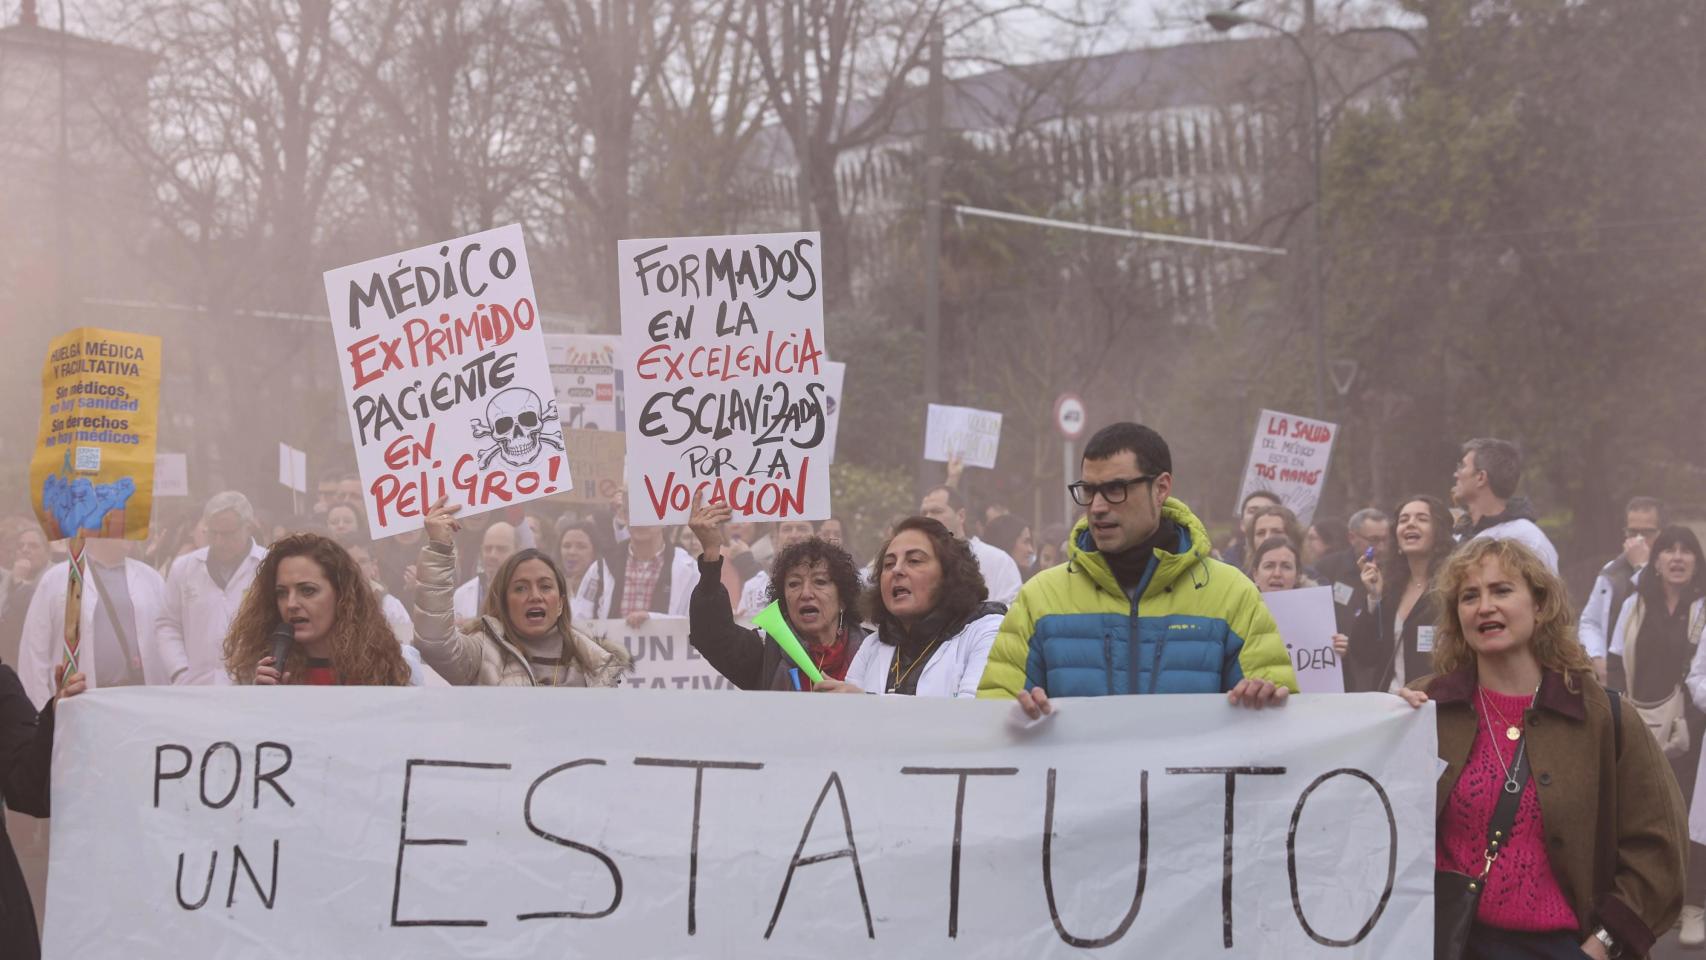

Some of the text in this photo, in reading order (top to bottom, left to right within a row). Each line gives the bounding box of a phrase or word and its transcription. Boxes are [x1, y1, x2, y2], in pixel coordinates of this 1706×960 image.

[633, 238, 817, 301] FORMADOS
[648, 300, 759, 342] EN LA
[85, 340, 144, 361] MÉDICA
[61, 359, 140, 377] FACULTATIVA
[70, 380, 129, 399] médicos,
[78, 396, 139, 412] sanidad
[66, 415, 129, 430] derechos
[1267, 416, 1331, 443] LA SALUD
[76, 429, 140, 445] médicos
[384, 422, 436, 470] EN
[1261, 438, 1277, 449] DEL
[680, 445, 791, 480] POR LA
[1255, 463, 1322, 486] TUS MANOS
[624, 635, 674, 661] UN
[153, 740, 296, 809] POR
[389, 757, 1398, 949] ESTATUTO
[175, 839, 280, 911] UN
